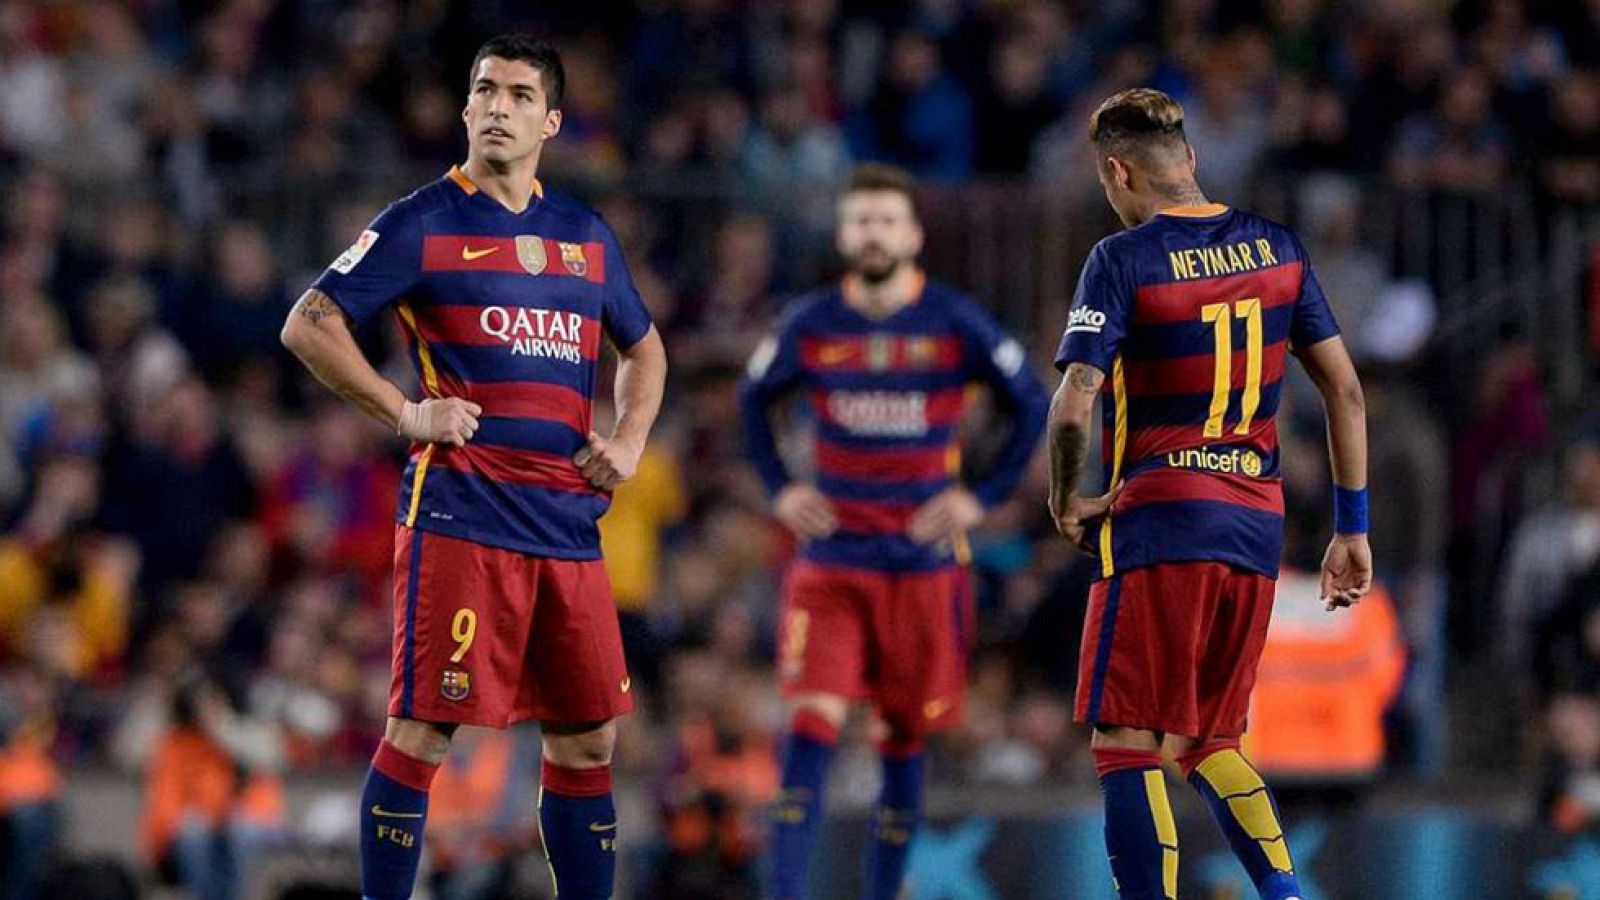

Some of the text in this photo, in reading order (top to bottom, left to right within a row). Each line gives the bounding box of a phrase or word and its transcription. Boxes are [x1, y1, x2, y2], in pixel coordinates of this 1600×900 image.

[1169, 237, 1278, 280] NEYMAR JR
[480, 306, 582, 343] QATAR
[1067, 304, 1106, 327] eko
[511, 337, 581, 364] AIRWAYS
[1201, 298, 1263, 438] 11
[1168, 447, 1242, 473] unicef
[449, 607, 478, 663] 9
[376, 824, 414, 848] FCB
